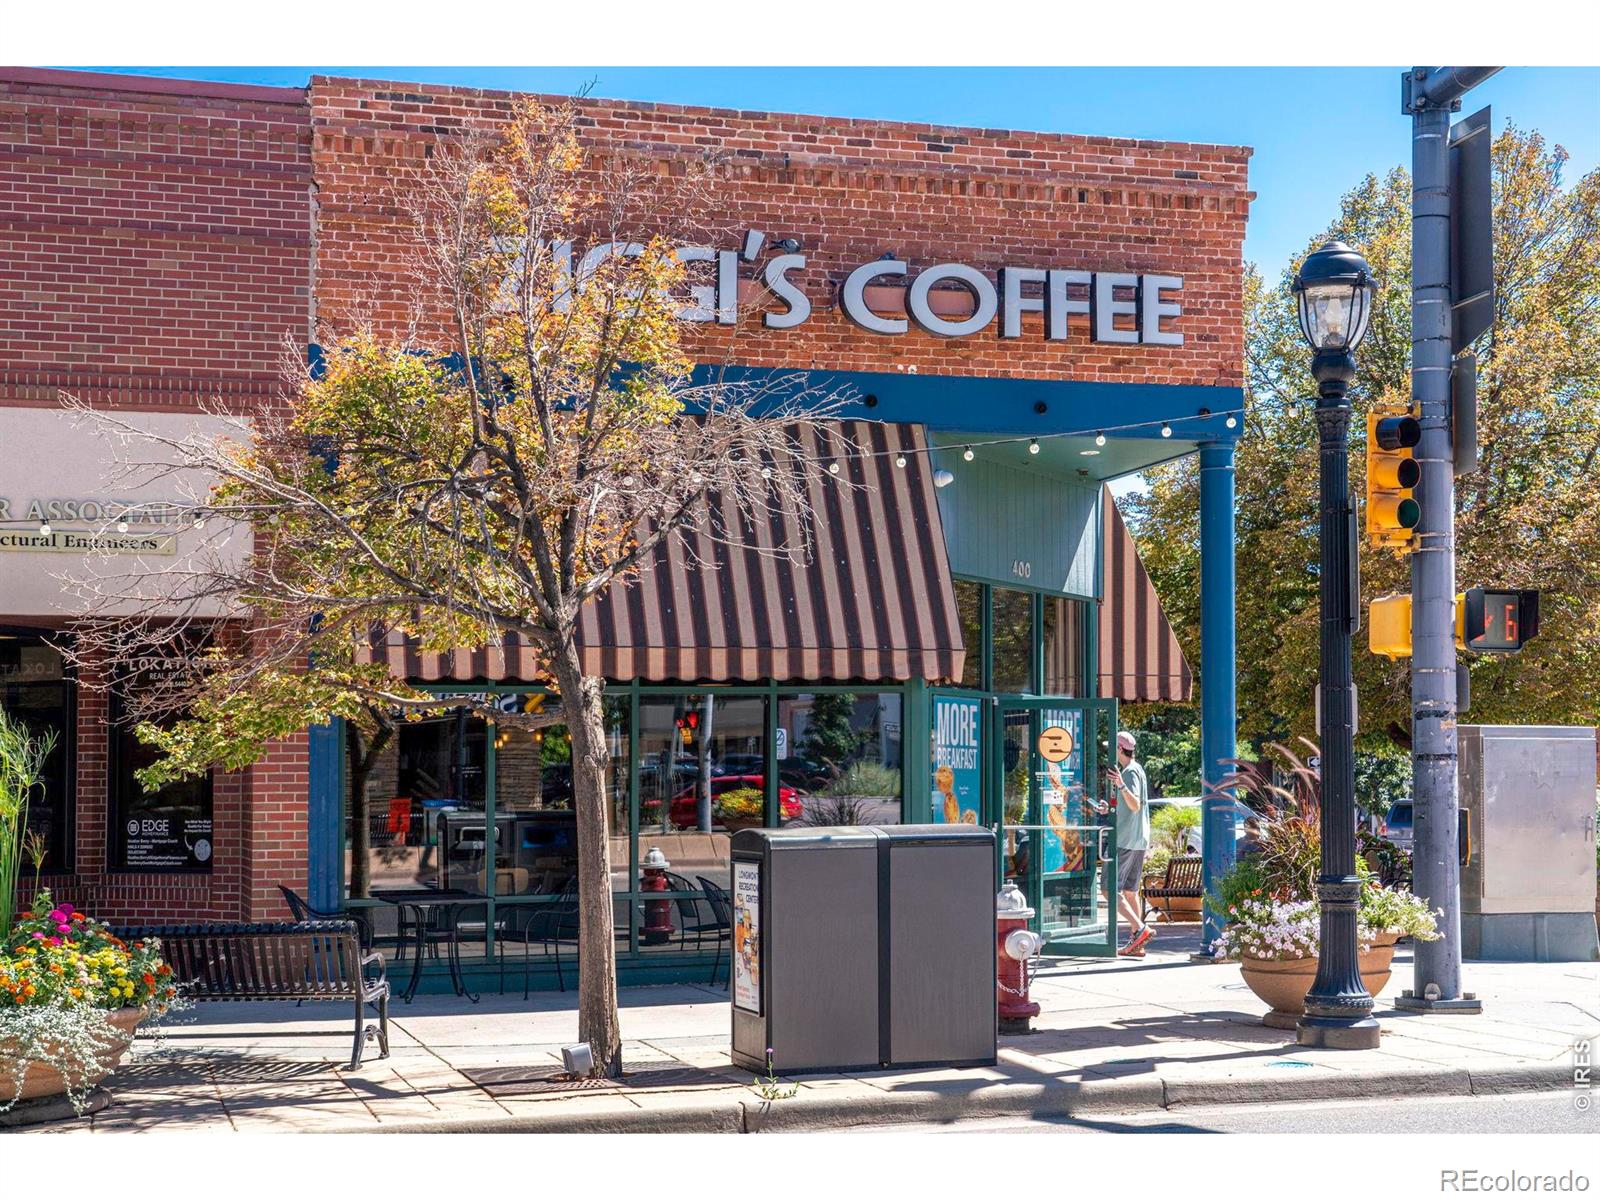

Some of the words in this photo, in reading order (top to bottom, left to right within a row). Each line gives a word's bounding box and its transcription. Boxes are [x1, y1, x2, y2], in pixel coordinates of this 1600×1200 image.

[840, 259, 1185, 346] COFFEE
[27, 499, 197, 526] ASSOIAT
[0, 534, 57, 548] ctural
[64, 534, 158, 551] Engineers
[1012, 560, 1031, 578] 400
[1505, 604, 1518, 641] 6
[149, 672, 166, 680] REAL
[937, 703, 978, 747] MORE
[937, 747, 978, 770] BREAKFAST
[141, 819, 170, 832] EDGE
[745, 894, 758, 904] CENTE
